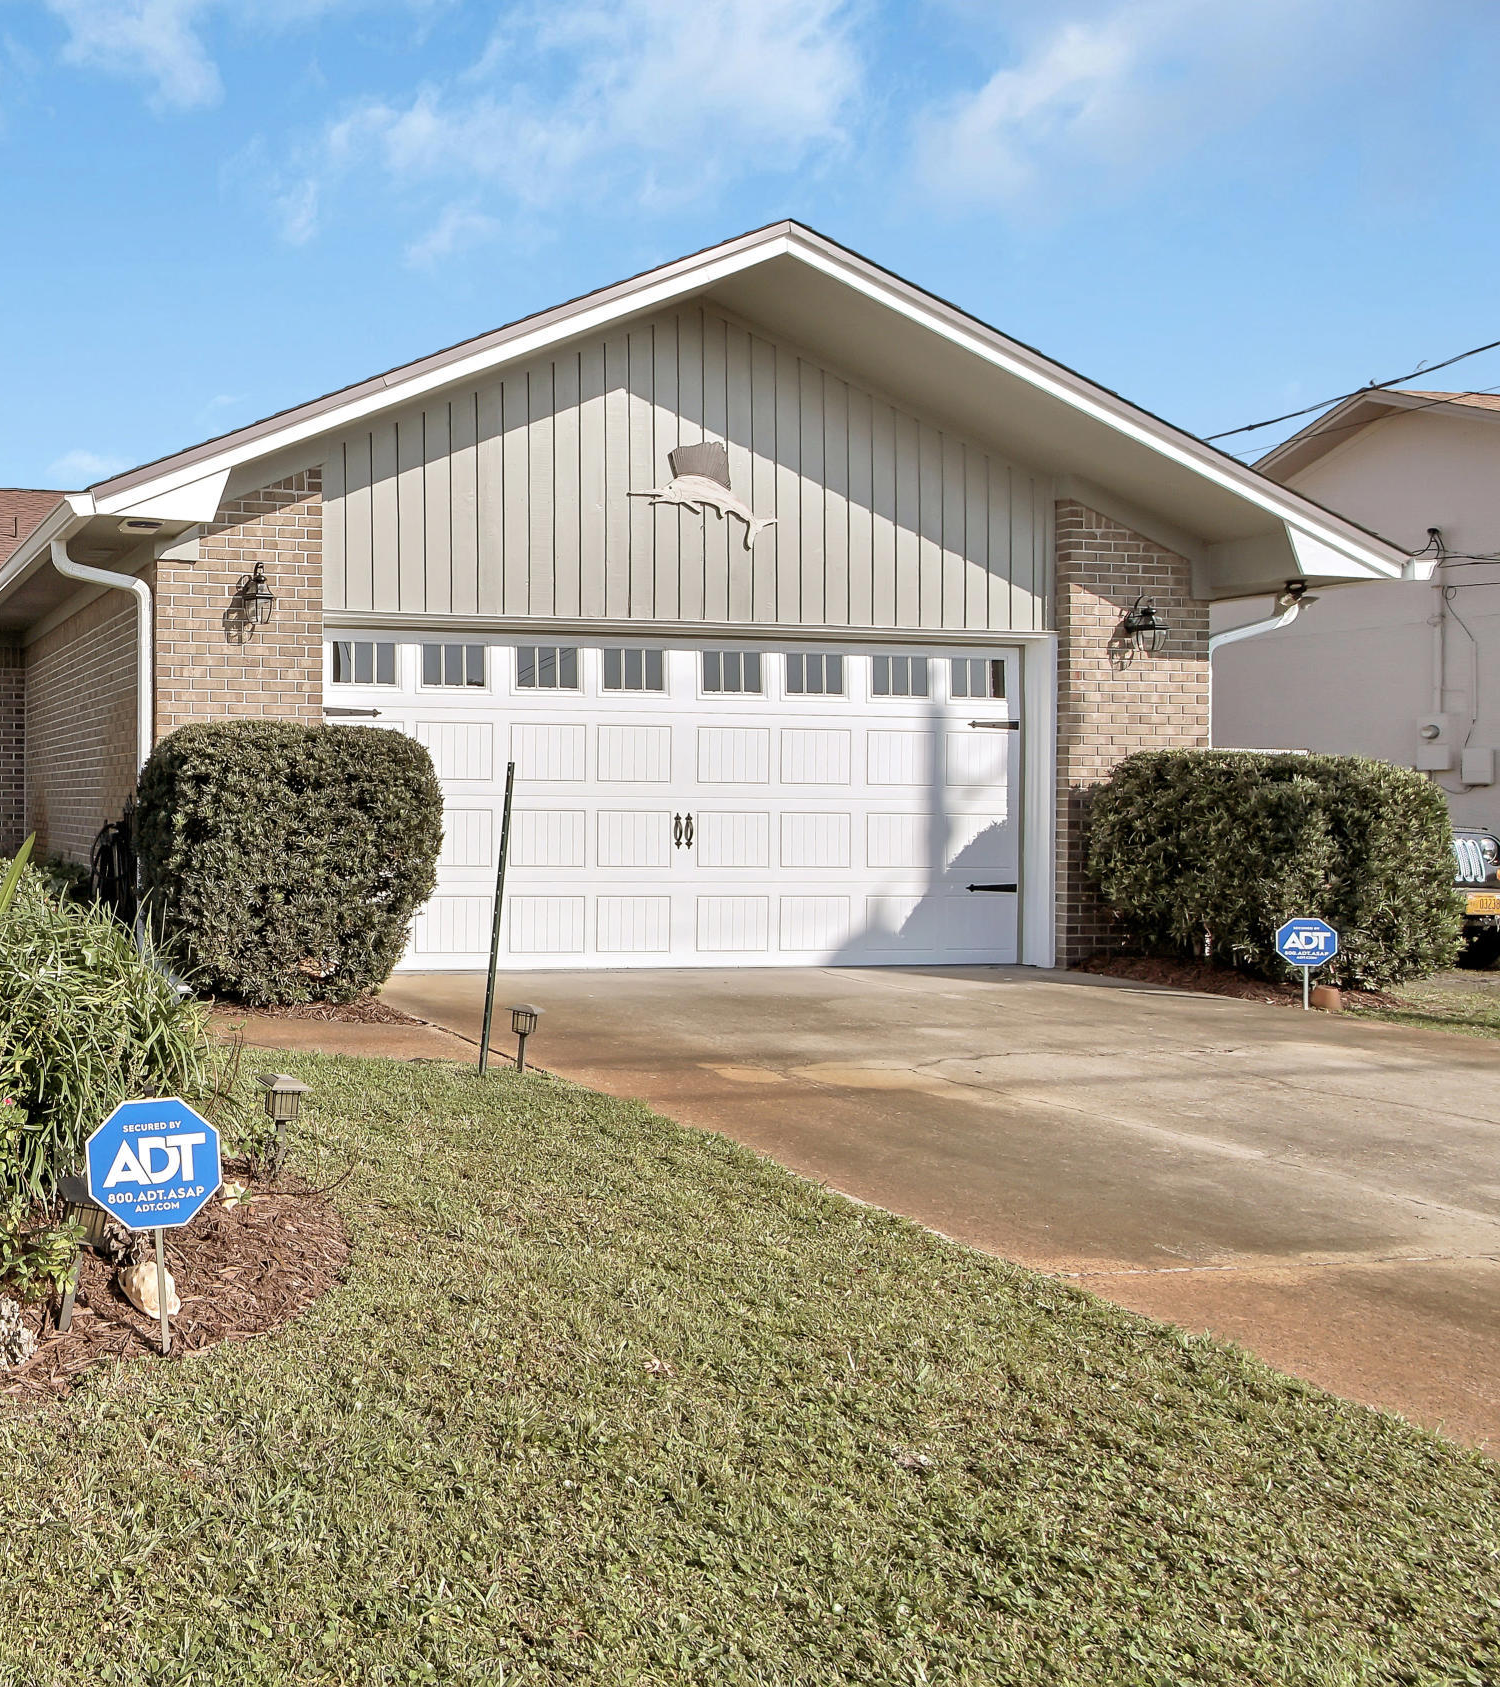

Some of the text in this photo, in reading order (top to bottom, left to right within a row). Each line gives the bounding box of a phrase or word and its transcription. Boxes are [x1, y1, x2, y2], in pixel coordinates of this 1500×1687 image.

[1282, 931, 1331, 950] ADT
[122, 1120, 182, 1133] SECURED BY
[102, 1132, 206, 1188] ADT
[107, 1186, 205, 1205] 800.ADT.ASAP
[135, 1201, 180, 1213] ADT.COM
